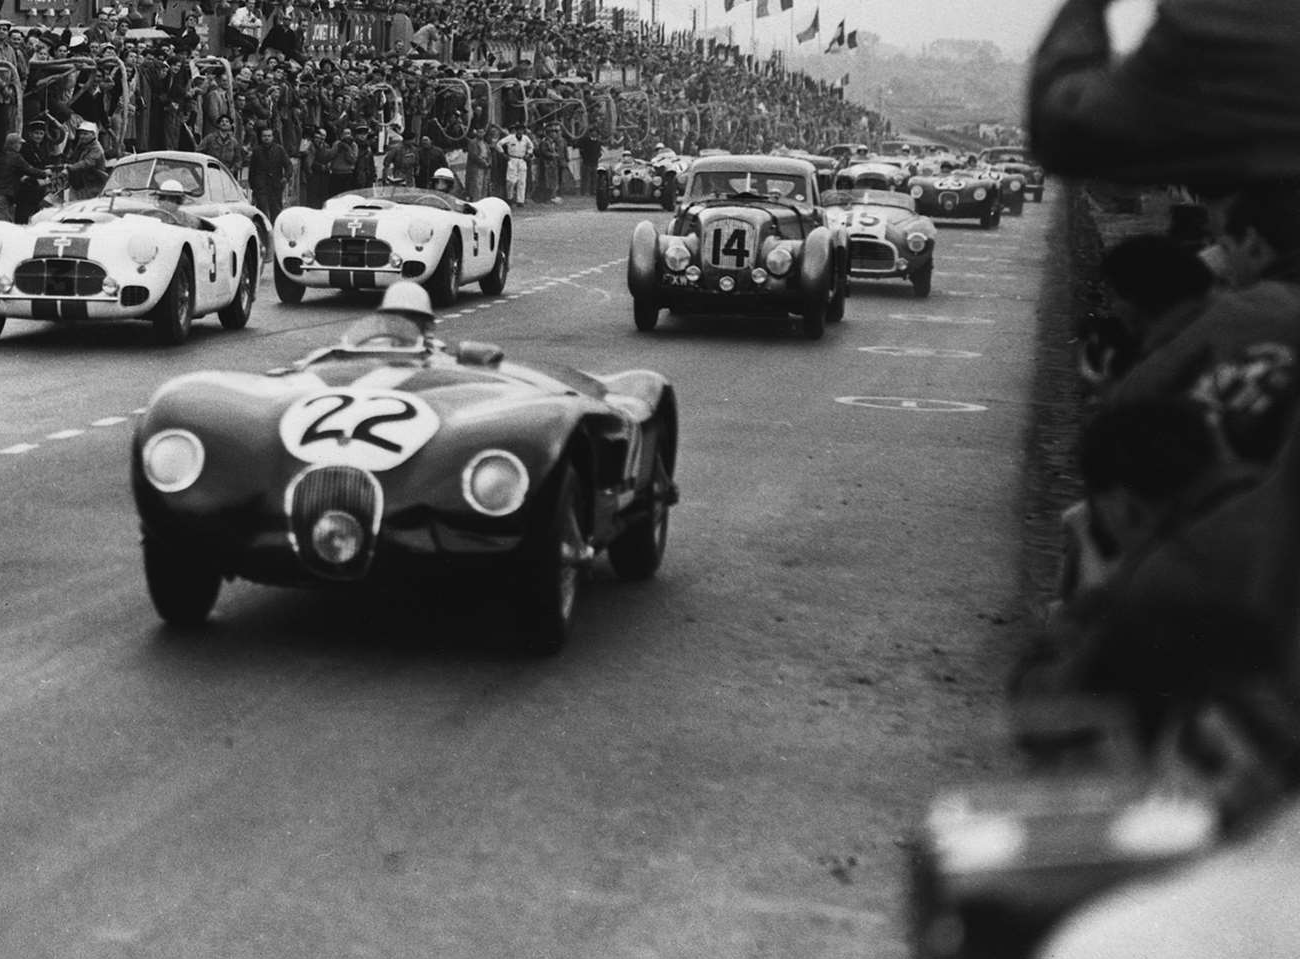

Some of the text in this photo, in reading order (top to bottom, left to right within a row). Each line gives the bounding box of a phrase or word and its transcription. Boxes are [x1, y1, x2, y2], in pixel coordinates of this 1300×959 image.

[208, 236, 217, 283] 3
[712, 228, 750, 268] 14
[300, 394, 419, 454] 22
